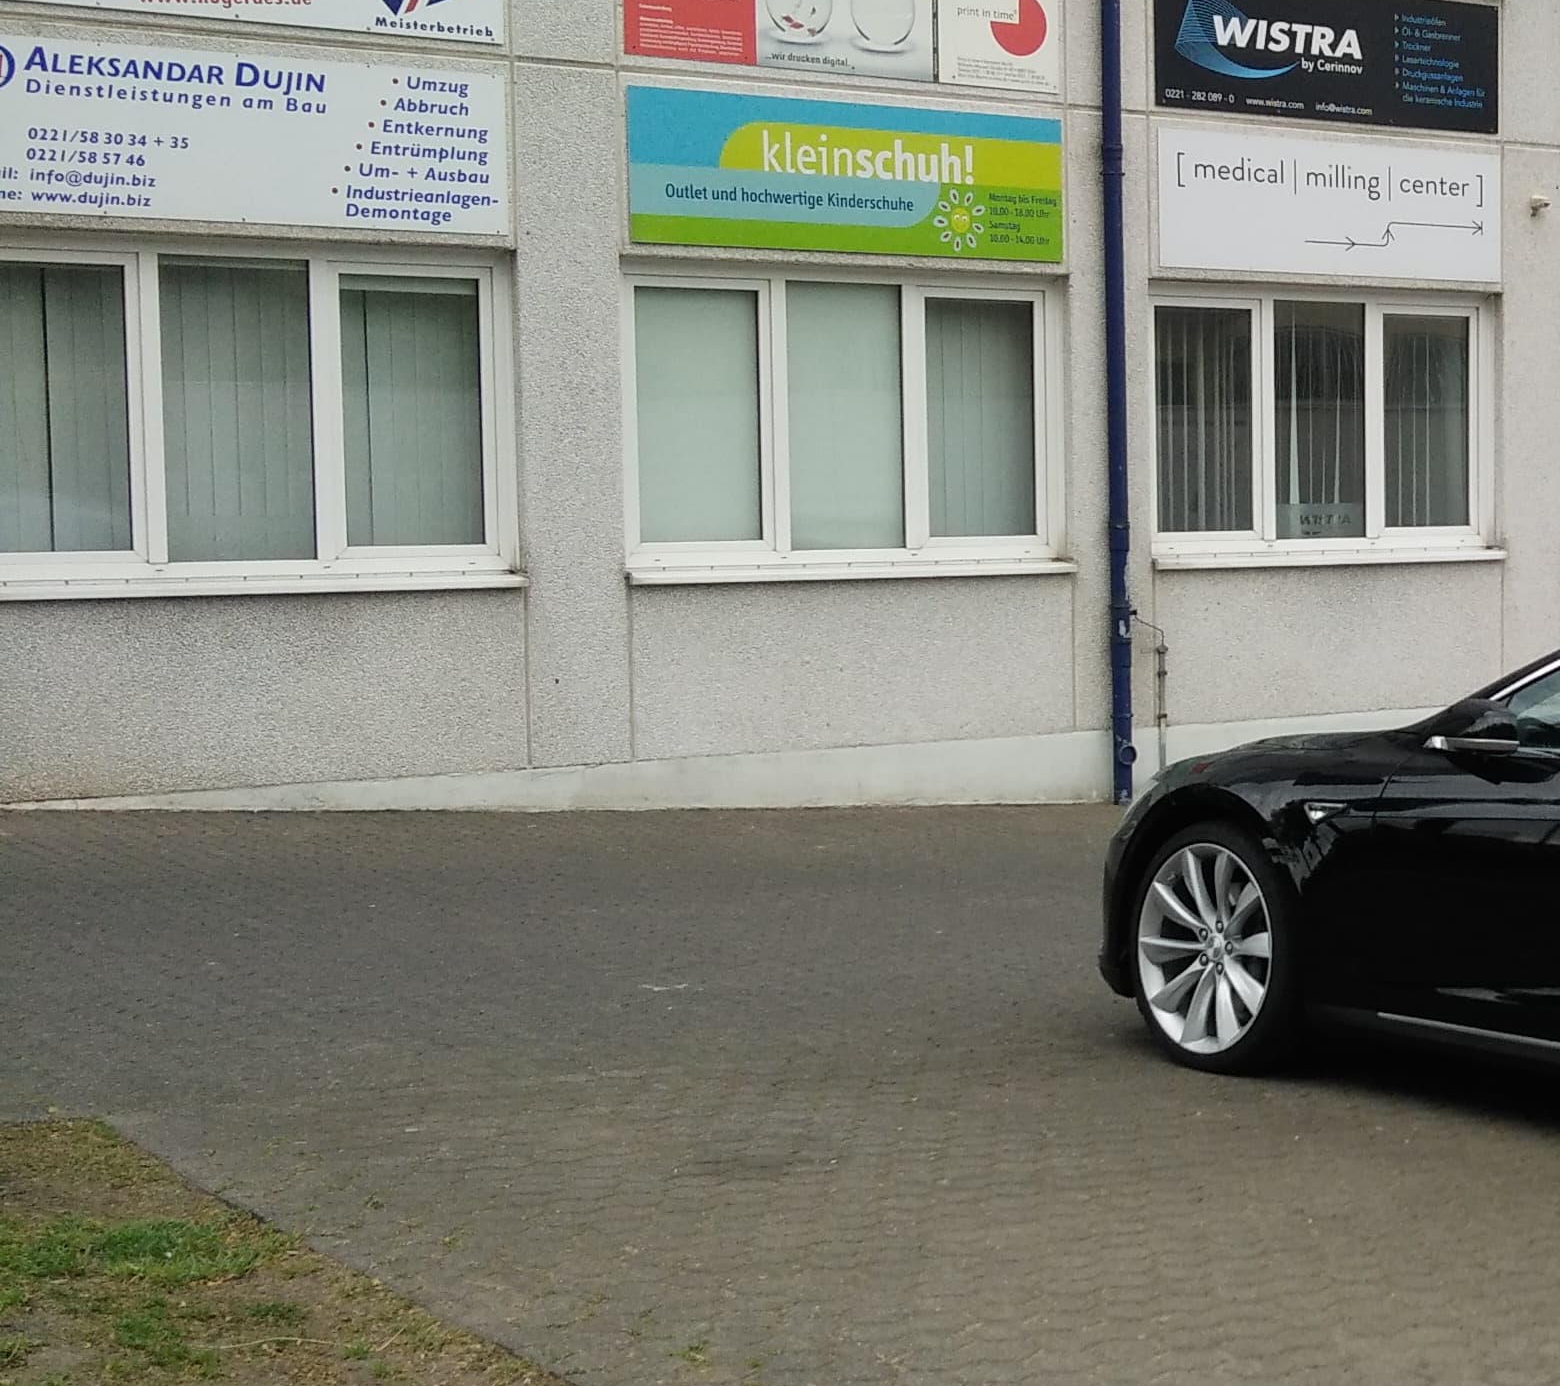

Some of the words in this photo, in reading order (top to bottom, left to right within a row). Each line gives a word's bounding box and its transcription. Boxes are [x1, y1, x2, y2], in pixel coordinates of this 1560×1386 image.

[957, 6, 979, 18] print
[982, 8, 991, 18] in
[375, 16, 493, 37] Meisterbetrieb
[1213, 15, 1363, 60] WISTRA
[787, 52, 820, 64] drucken
[1301, 57, 1314, 72] by
[1317, 59, 1363, 74] Cerinnov
[24, 46, 224, 85] ALEKSANDAR
[235, 61, 325, 95] DUJIN
[26, 78, 231, 109] Dienstleistungen
[243, 98, 273, 110] am
[286, 97, 326, 114] Bau
[407, 76, 469, 98] Umzug
[1165, 88, 1184, 99] 0221
[394, 97, 469, 116] Abbruch
[1246, 98, 1304, 110] www.wistra.com
[1316, 102, 1373, 115] info@wistra.com
[28, 128, 99, 144] 0221/58
[104, 133, 124, 145] 30
[128, 134, 147, 147] 34
[169, 136, 189, 149] 35
[382, 119, 488, 144] Entkernung
[26, 148, 97, 164] 0221/58
[102, 152, 121, 165] 57
[126, 154, 146, 166] 46
[371, 141, 488, 166] Entrümplung
[762, 129, 975, 185] kleinschuh!
[30, 168, 156, 188] info@dujin.biz
[359, 163, 399, 178] Um-
[424, 167, 490, 184] Ausbau
[1194, 157, 1284, 184] medical
[1306, 164, 1381, 201] milling
[1400, 177, 1470, 197] center
[31, 191, 152, 208] www.dujin.biz
[346, 185, 499, 209] Industrieanlagen-
[665, 183, 707, 200] Outlet
[711, 187, 737, 201] und
[741, 188, 823, 209] hochwertige
[827, 193, 914, 211] Kinderschuhe
[989, 193, 1017, 204] Montag
[1018, 194, 1030, 204] bis
[1031, 195, 1057, 207] Freitag
[346, 203, 452, 225] Demontage
[1036, 210, 1048, 218] Uhr
[989, 221, 1020, 232] Samstag
[1036, 236, 1049, 245] Uhr
